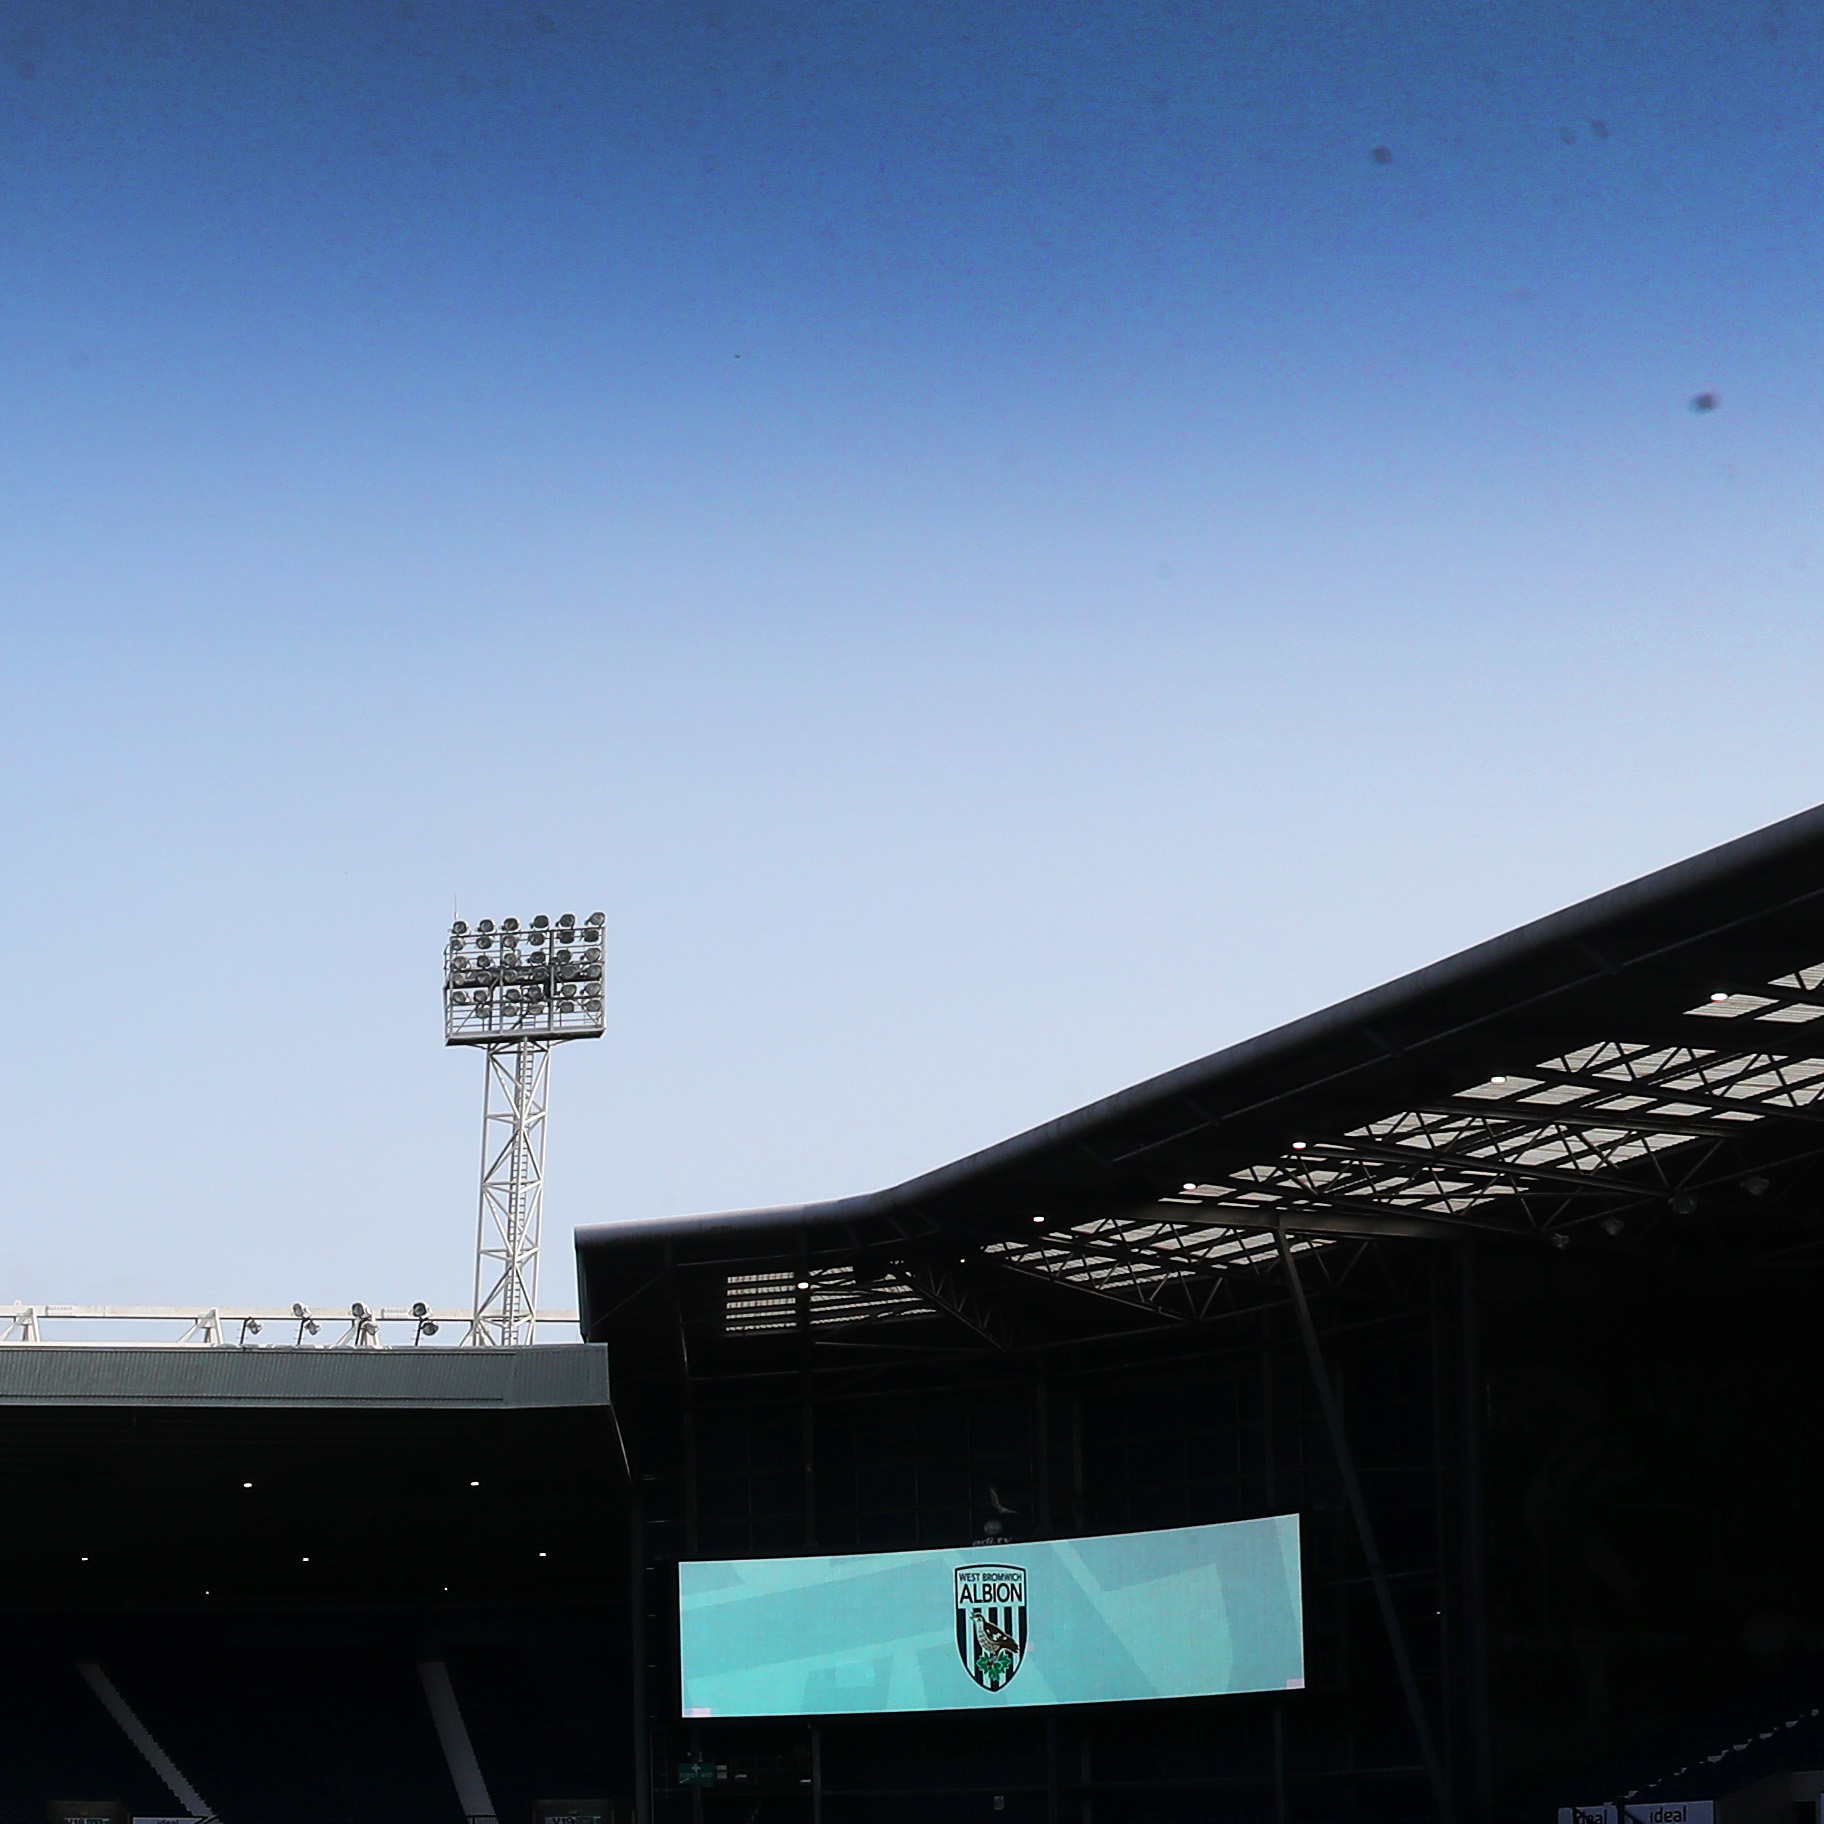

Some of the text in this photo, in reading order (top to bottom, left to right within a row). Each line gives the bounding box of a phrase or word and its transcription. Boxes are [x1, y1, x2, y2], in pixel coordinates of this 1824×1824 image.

[959, 1573, 980, 1582] WEST
[960, 1583, 1022, 1604] ALBION
[1651, 1806, 1686, 1824] ideal
